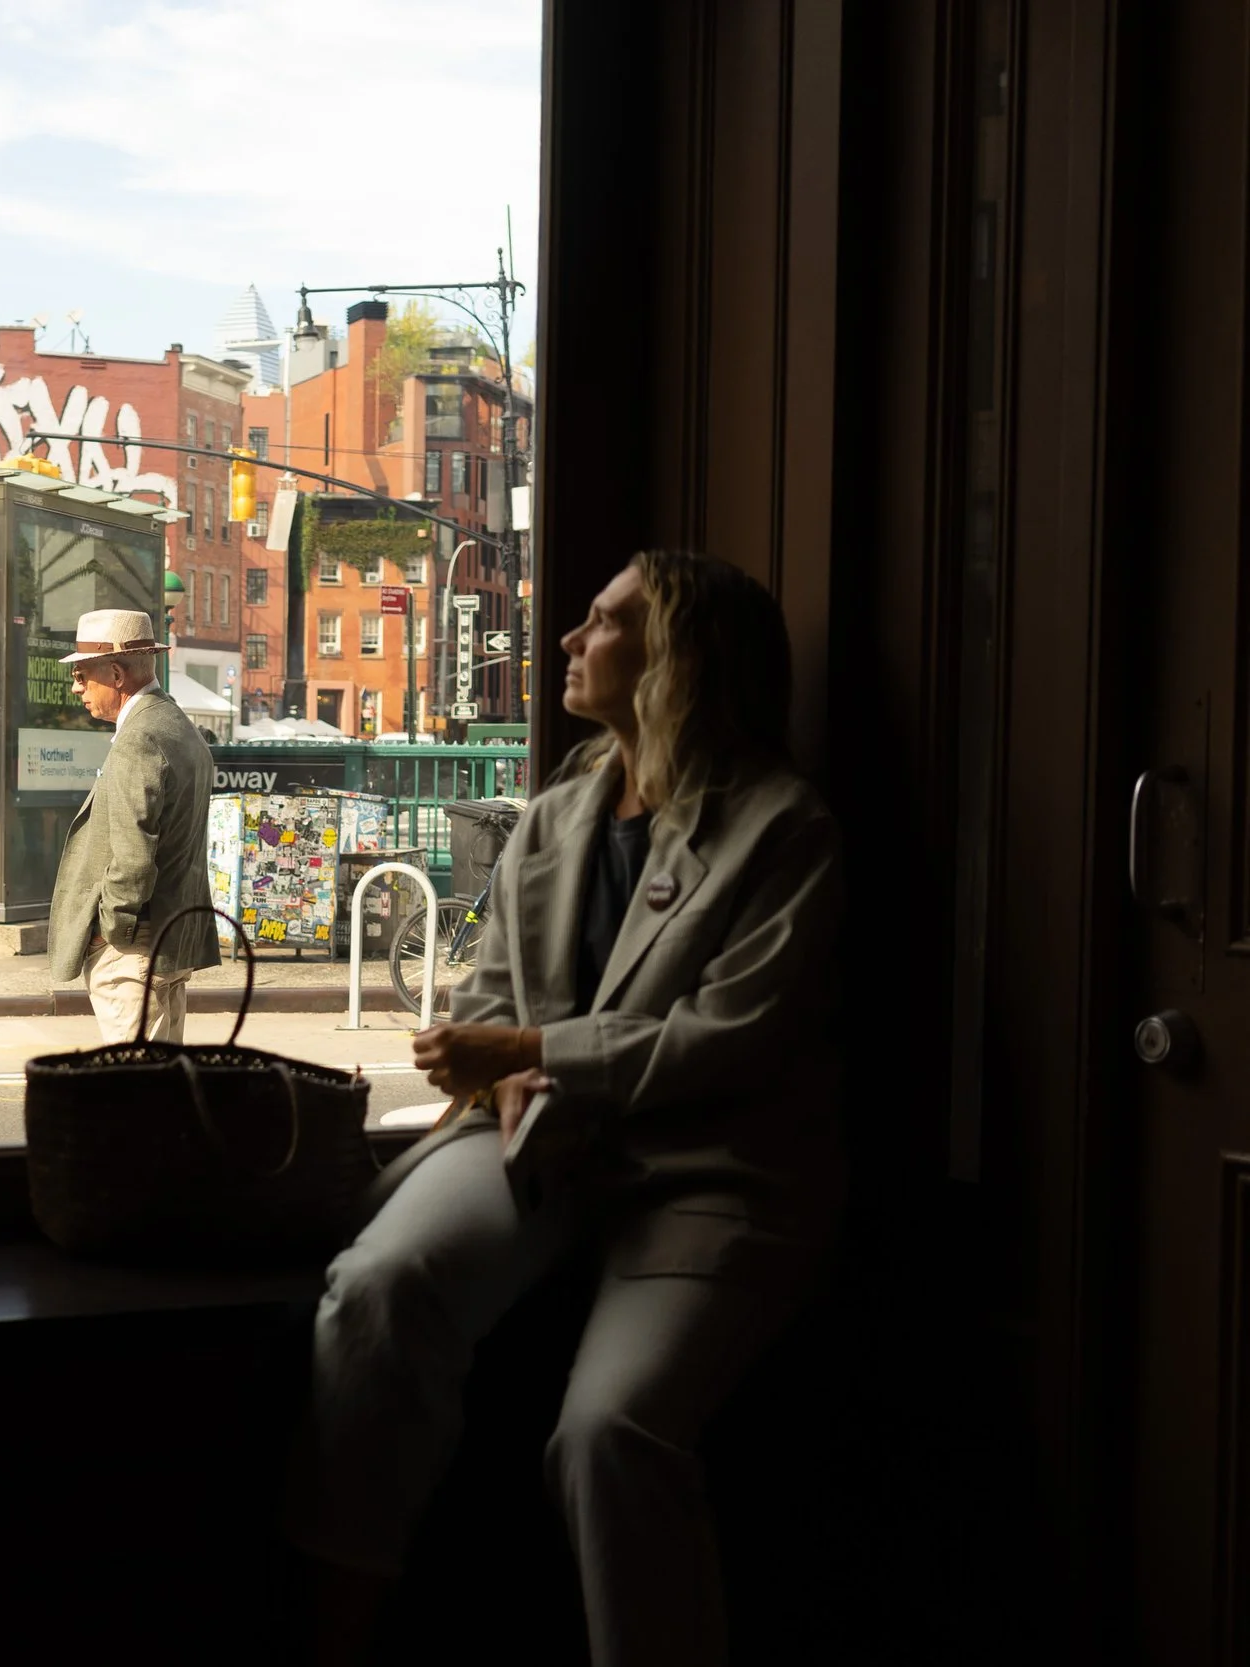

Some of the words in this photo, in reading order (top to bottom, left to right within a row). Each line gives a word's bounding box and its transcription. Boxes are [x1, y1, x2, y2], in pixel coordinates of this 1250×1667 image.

[27, 680, 64, 705] VILLAGE
[40, 748, 74, 762] Northwell
[68, 766, 85, 778] Village
